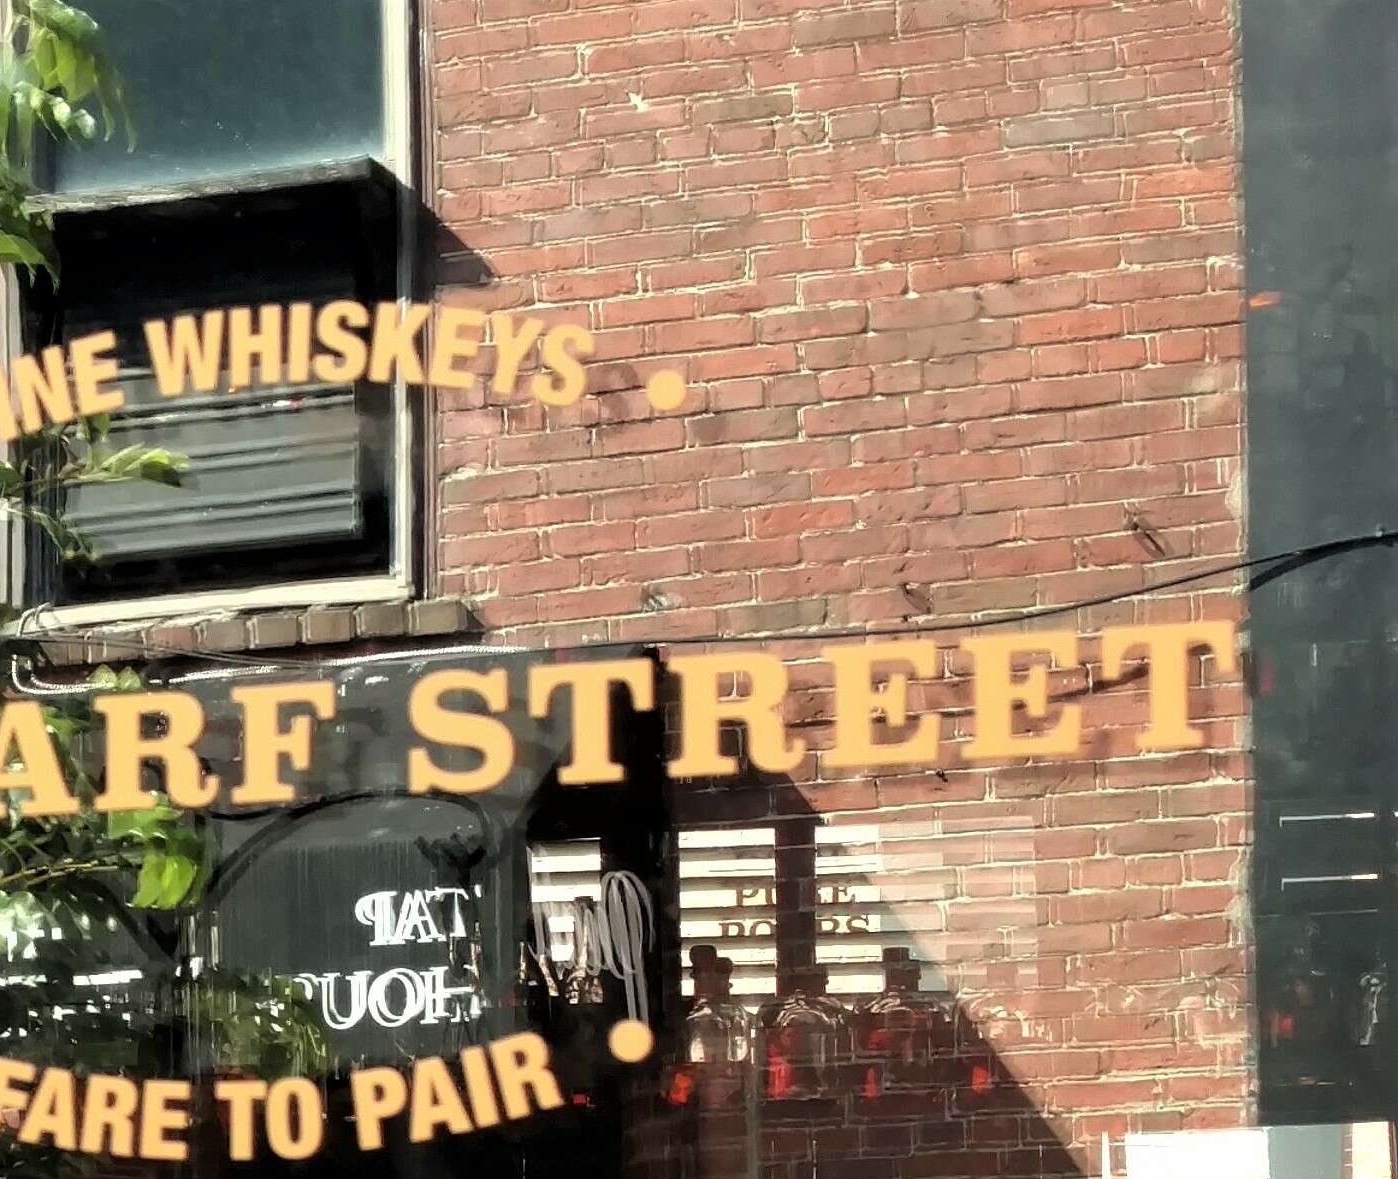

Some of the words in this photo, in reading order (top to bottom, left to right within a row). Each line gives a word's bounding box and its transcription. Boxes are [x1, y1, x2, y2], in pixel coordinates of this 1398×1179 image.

[144, 299, 595, 408] WHISKEYS
[407, 619, 1237, 795] STREET
[214, 1075, 324, 1161] TO
[351, 1031, 563, 1151] PAIR
